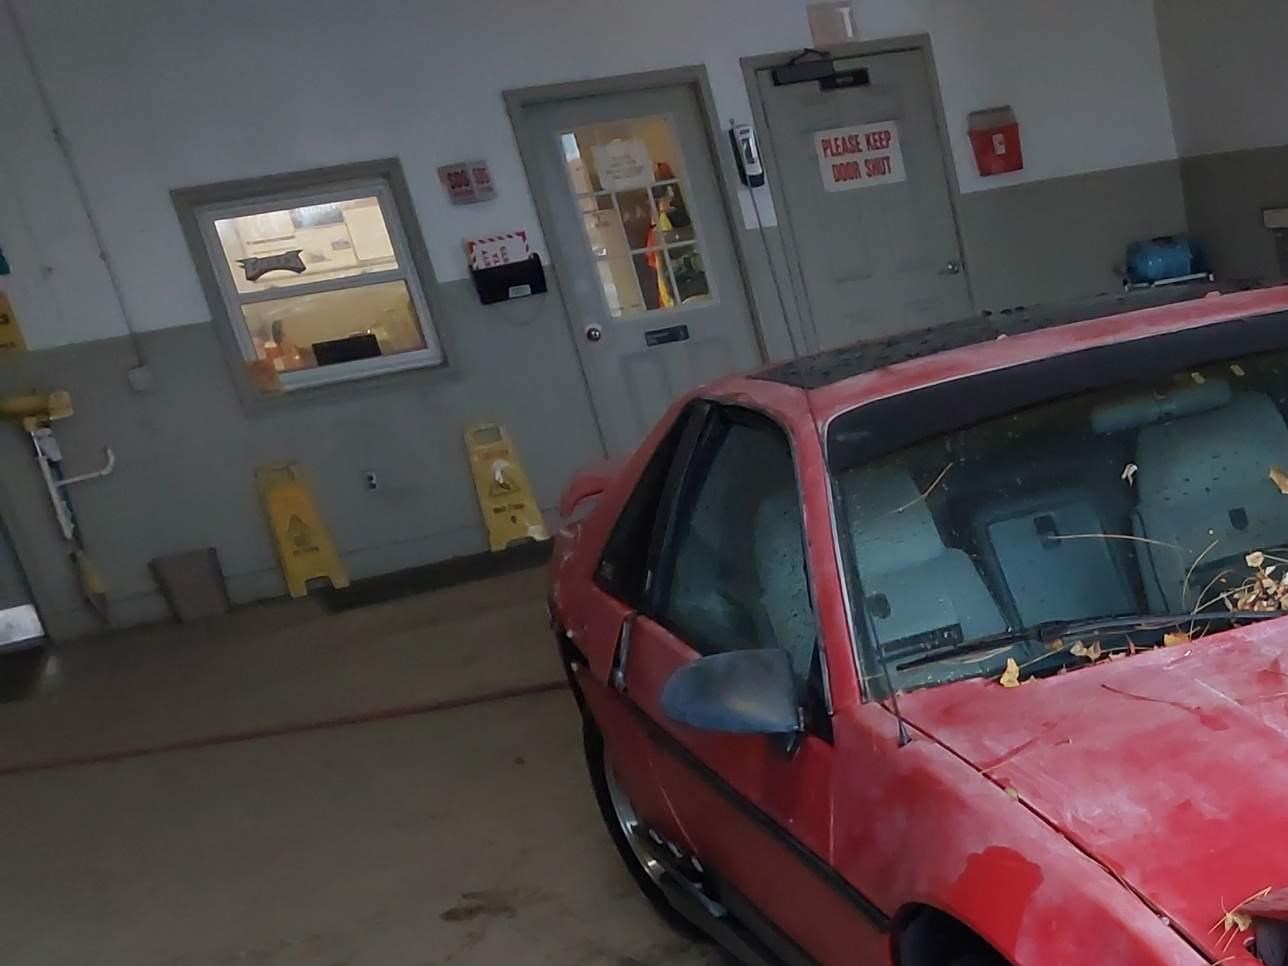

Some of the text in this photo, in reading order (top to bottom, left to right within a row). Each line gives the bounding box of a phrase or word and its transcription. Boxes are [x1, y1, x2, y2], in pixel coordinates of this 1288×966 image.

[821, 130, 892, 158] PLEASE KEEP
[831, 156, 892, 183] DOOR SHUT
